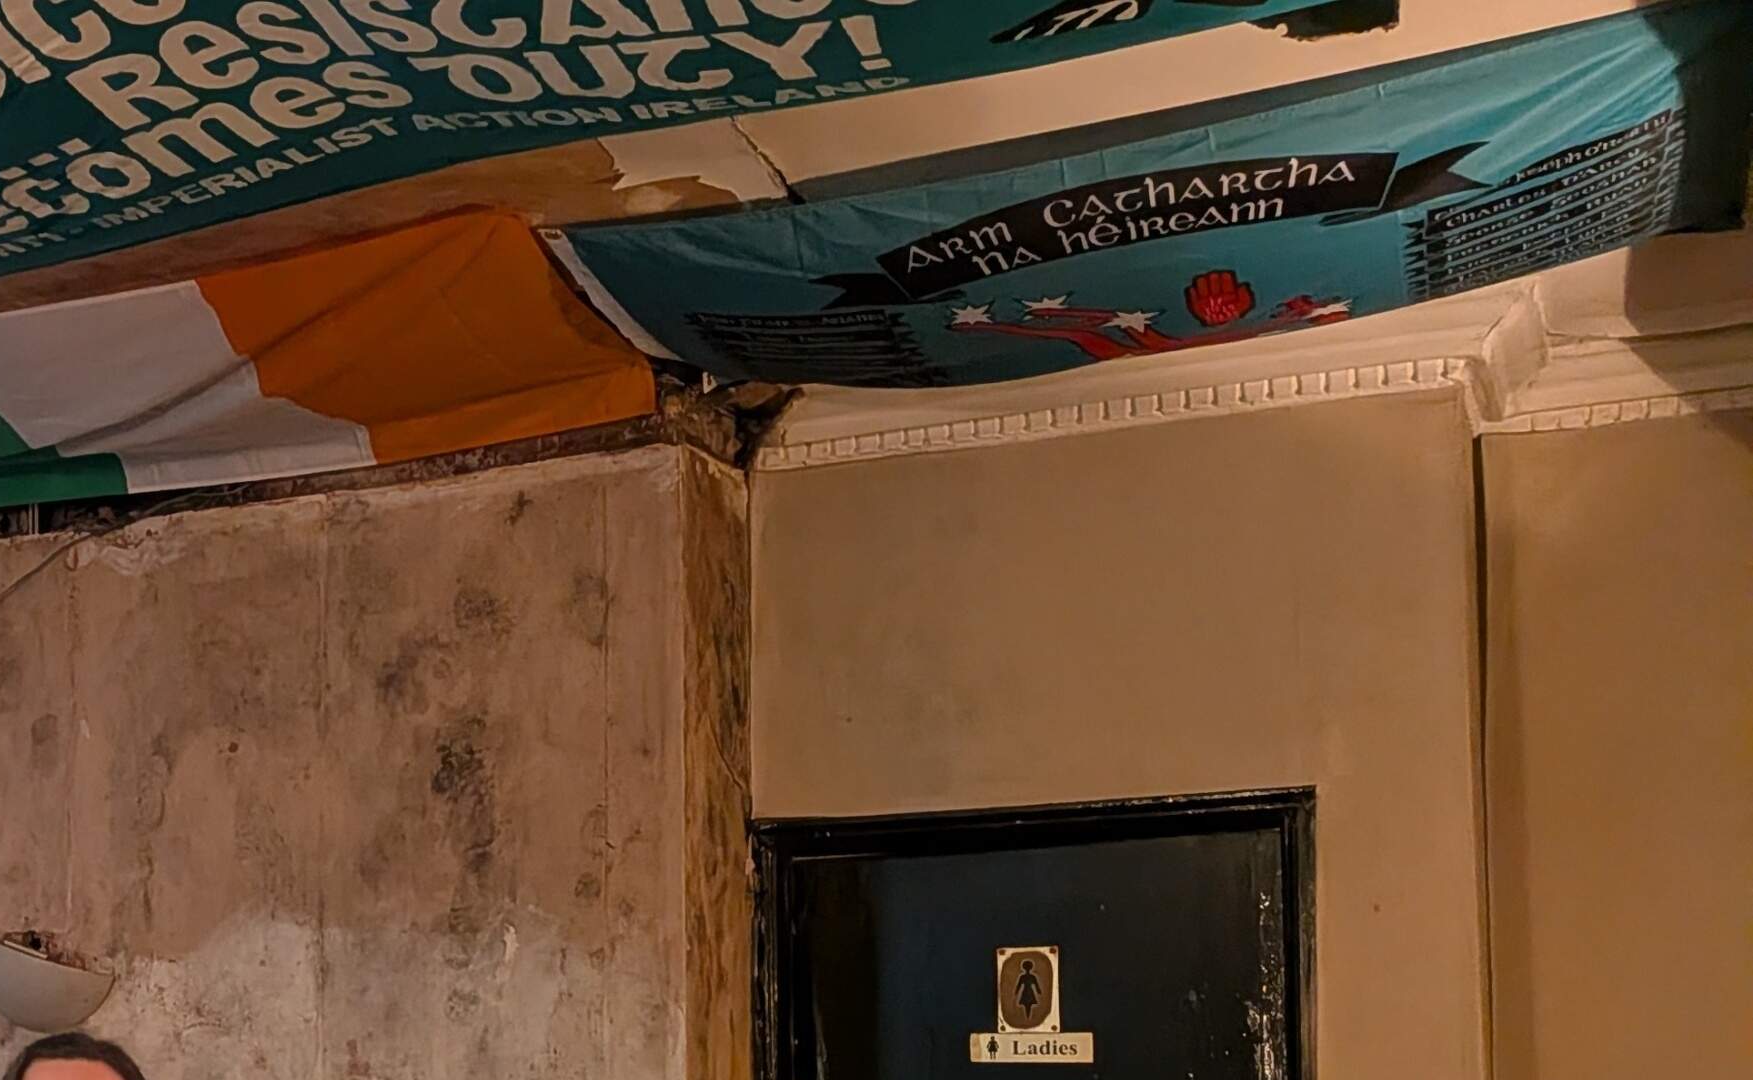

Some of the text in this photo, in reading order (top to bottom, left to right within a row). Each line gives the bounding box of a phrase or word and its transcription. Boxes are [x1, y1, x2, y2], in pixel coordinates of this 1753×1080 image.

[66, 0, 920, 130] Resista
[411, 107, 623, 131] ACTION
[631, 76, 910, 120] IRELAND
[1012, 1040, 1078, 1056] Ladies
